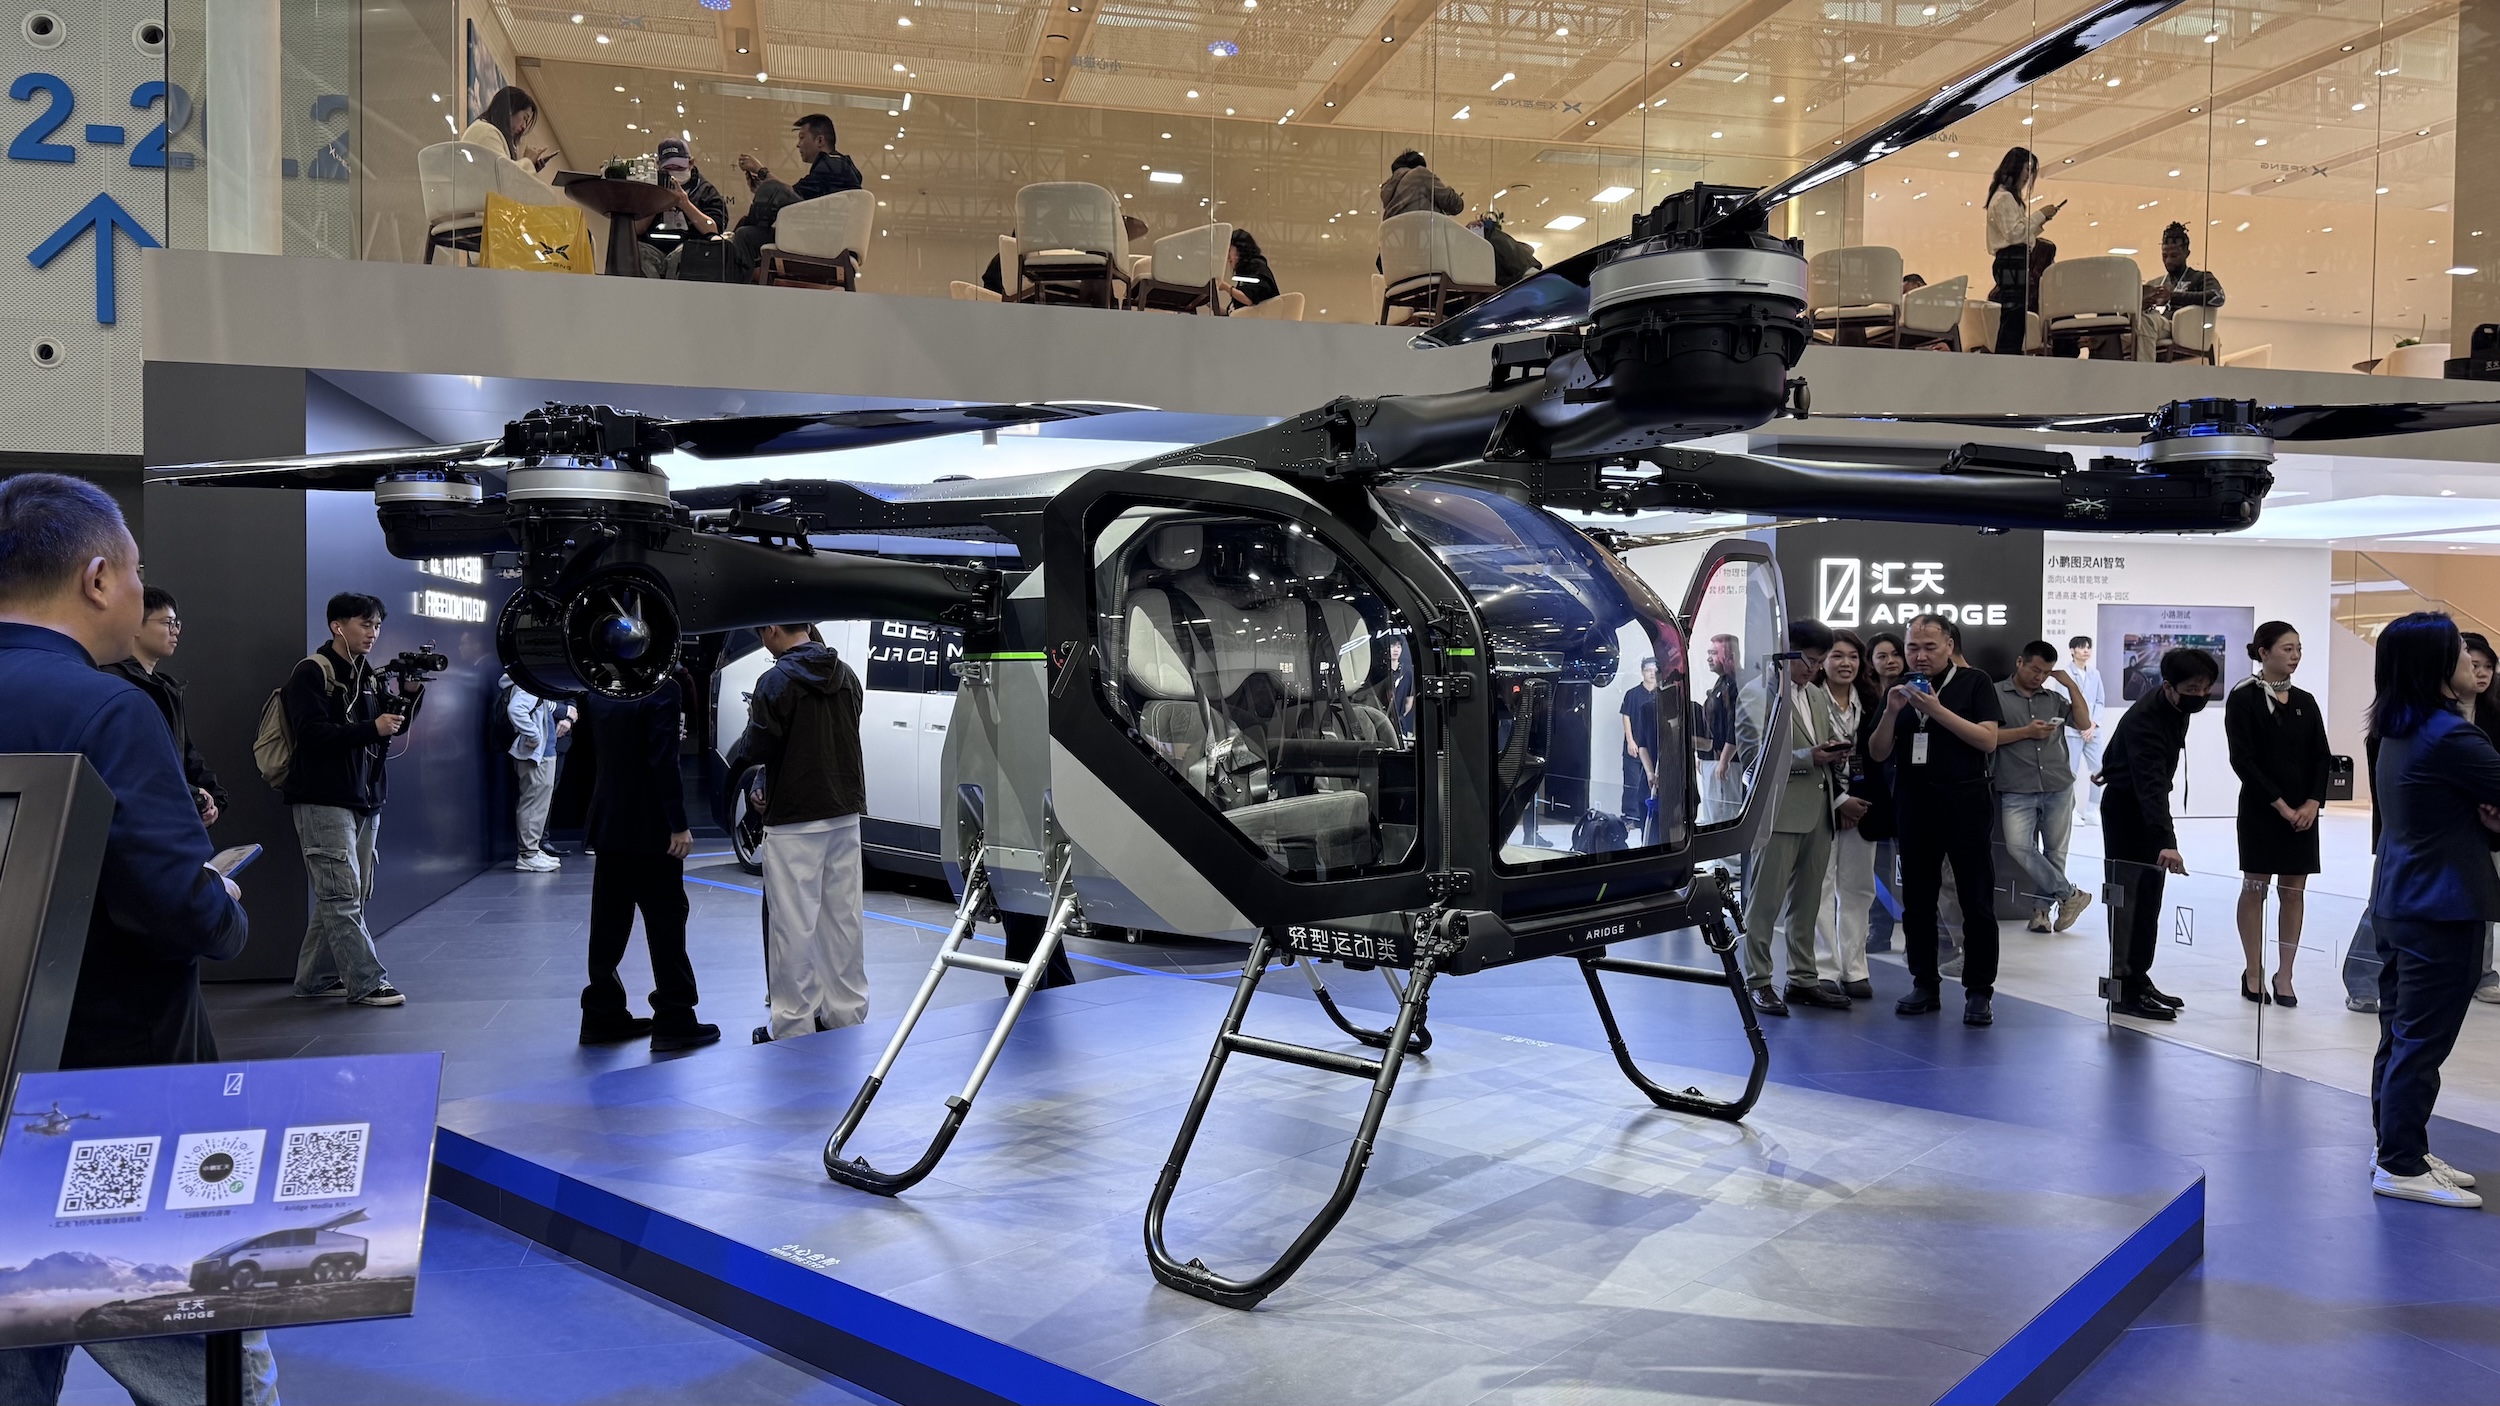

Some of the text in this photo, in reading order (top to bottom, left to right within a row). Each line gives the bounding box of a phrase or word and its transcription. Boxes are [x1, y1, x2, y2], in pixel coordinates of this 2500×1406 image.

[2048, 555, 2125, 569] 小鹏图灵AI智驾
[1871, 562, 1945, 595] 汇天
[1585, 924, 1625, 941] ARIDGE
[1288, 926, 1399, 962] 轻型运动类
[177, 1299, 206, 1311] 汇天
[163, 1310, 216, 1321] ARIDGE
